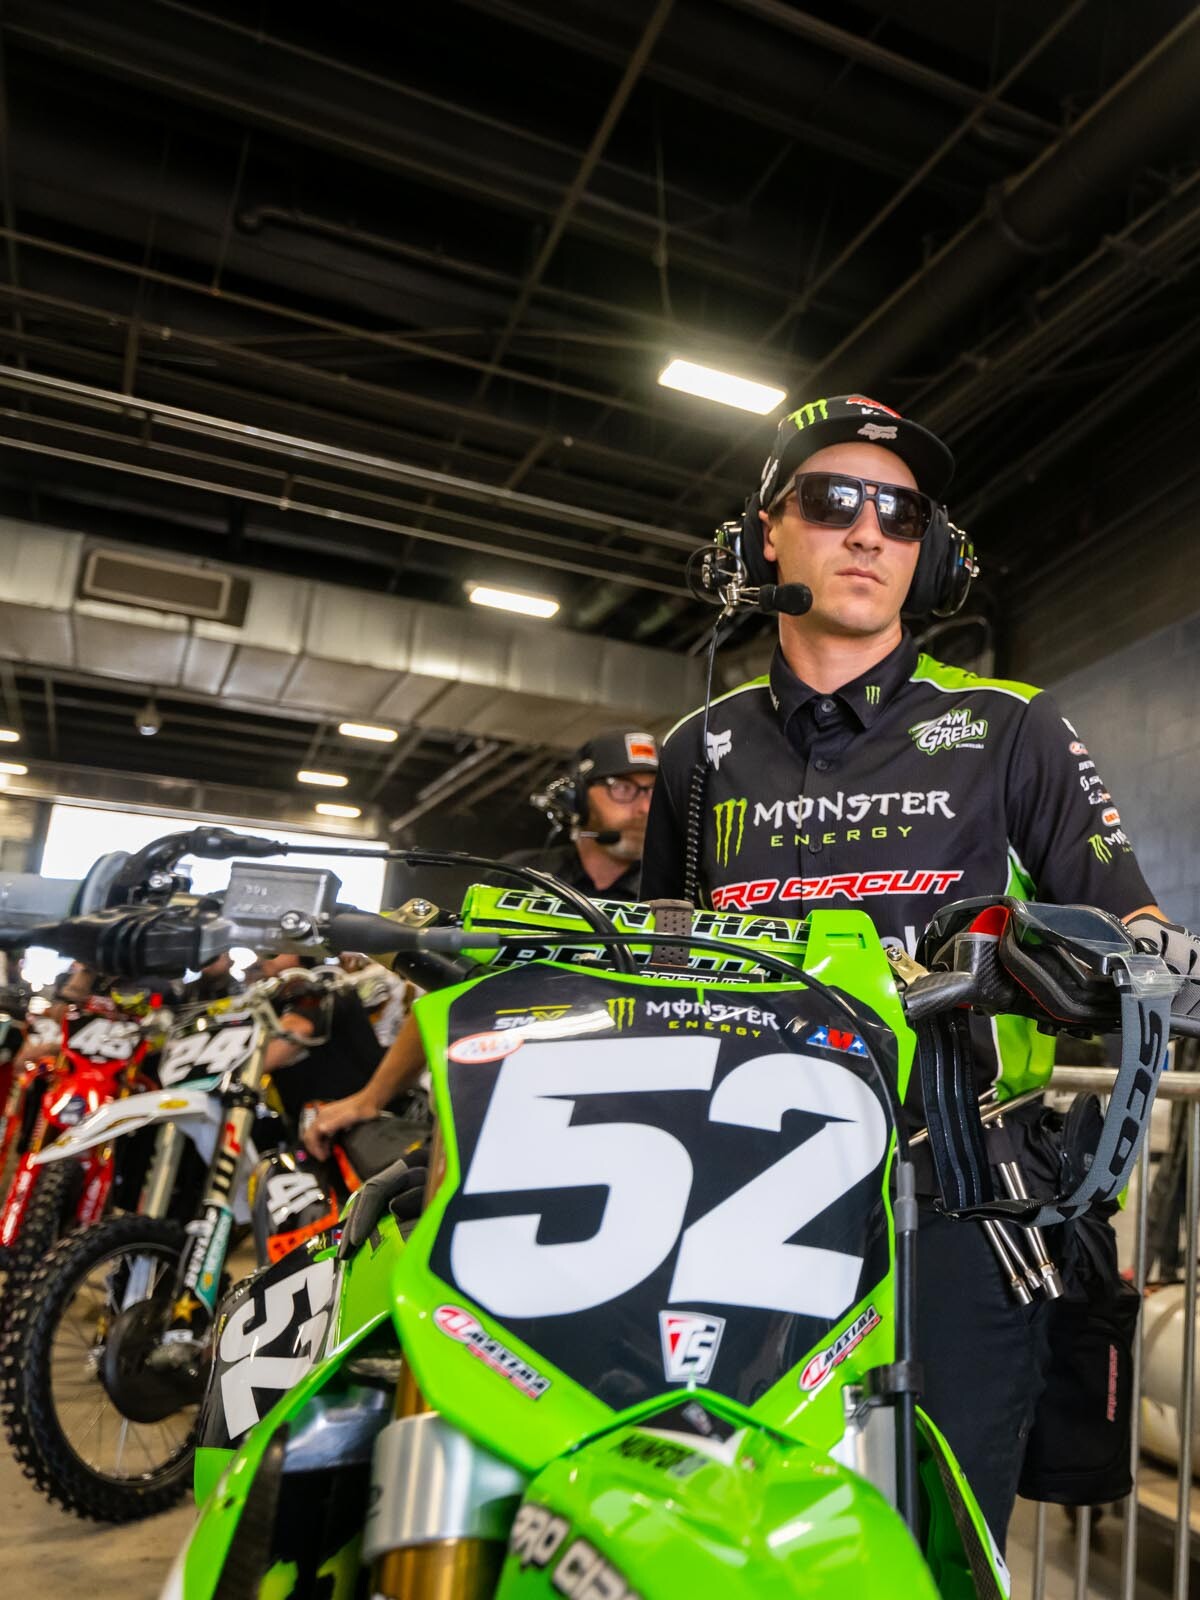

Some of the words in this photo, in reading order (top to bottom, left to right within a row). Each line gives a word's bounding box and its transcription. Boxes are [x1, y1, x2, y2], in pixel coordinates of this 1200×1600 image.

[919, 722, 984, 751] GREEN
[754, 790, 955, 829] MONSTER
[771, 826, 913, 846] ENERGY
[711, 879, 779, 911] PRO
[780, 870, 964, 899] CIRCUIT
[646, 1000, 780, 1031] MONSTER
[669, 1020, 761, 1038] ENERGY
[159, 1025, 254, 1088] 24
[806, 1026, 869, 1058] AMA
[451, 1037, 889, 1319] 52
[219, 1257, 335, 1441] 52
[823, 1305, 877, 1366] MAXIMA
[464, 1331, 552, 1392] MAXIMA
[512, 1503, 570, 1565] PRO
